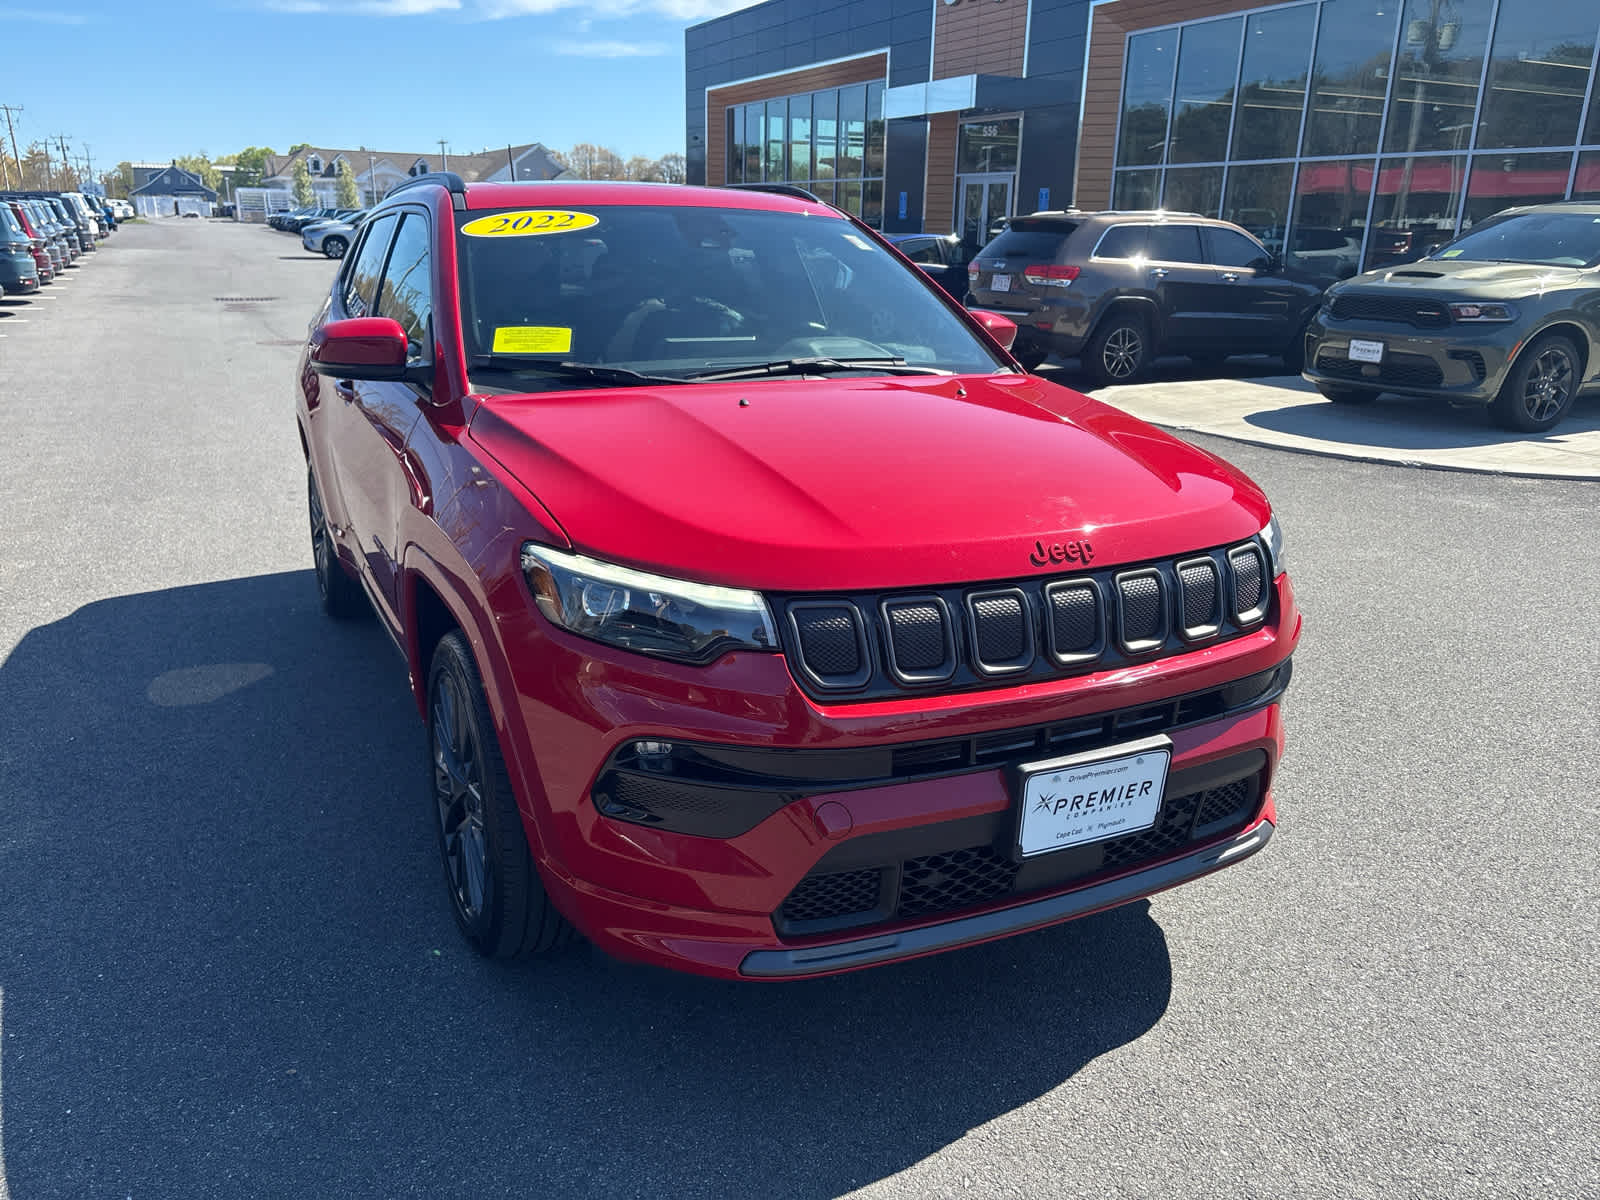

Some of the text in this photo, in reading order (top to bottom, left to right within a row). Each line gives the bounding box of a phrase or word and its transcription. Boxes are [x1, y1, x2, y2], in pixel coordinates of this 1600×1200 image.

[488, 214, 575, 233] 2022
[1029, 540, 1095, 567] Jeep
[1068, 766, 1128, 782] DrivePremier.com
[1053, 780, 1152, 815] PREMIER
[1066, 801, 1132, 820] COMPANIES
[1056, 831, 1071, 839] Cape
[1098, 818, 1125, 830] Plymouth
